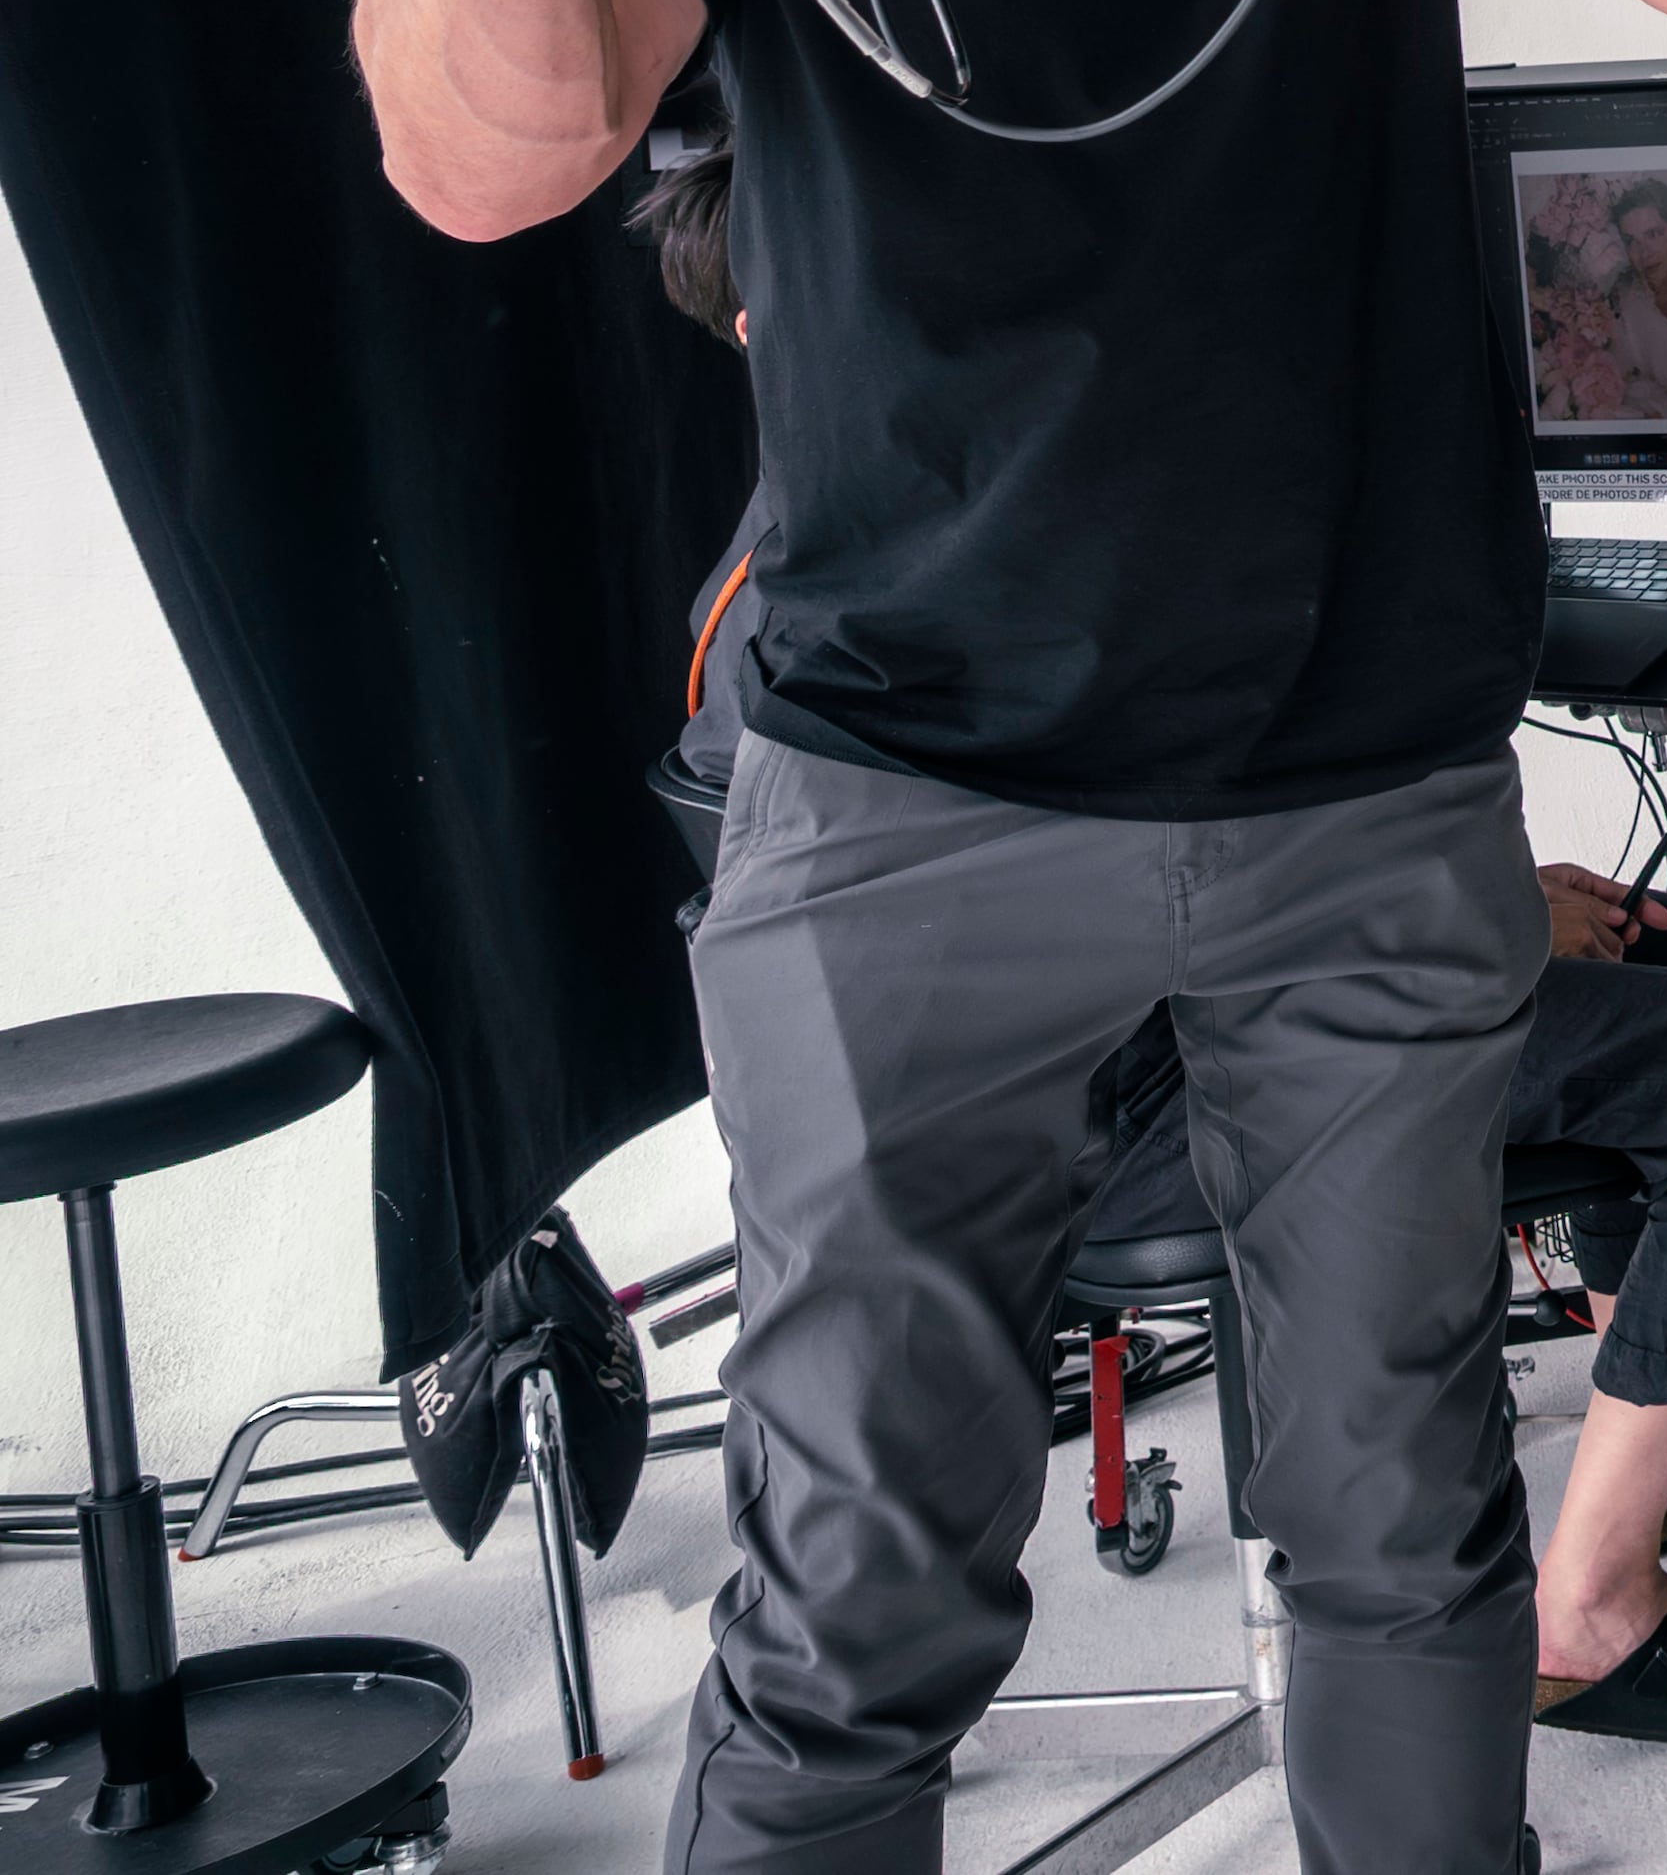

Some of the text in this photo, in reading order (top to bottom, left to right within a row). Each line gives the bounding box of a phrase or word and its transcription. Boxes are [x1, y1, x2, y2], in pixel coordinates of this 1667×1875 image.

[1562, 473, 1607, 484] PHOTOS
[1608, 474, 1623, 484] OF
[1626, 474, 1650, 484] THIS
[1538, 490, 1574, 500] ENDRE
[1576, 489, 1591, 499] DE
[1593, 489, 1637, 500] PHOTOS
[1639, 489, 1654, 500] DE
[411, 1352, 455, 1438] ing
